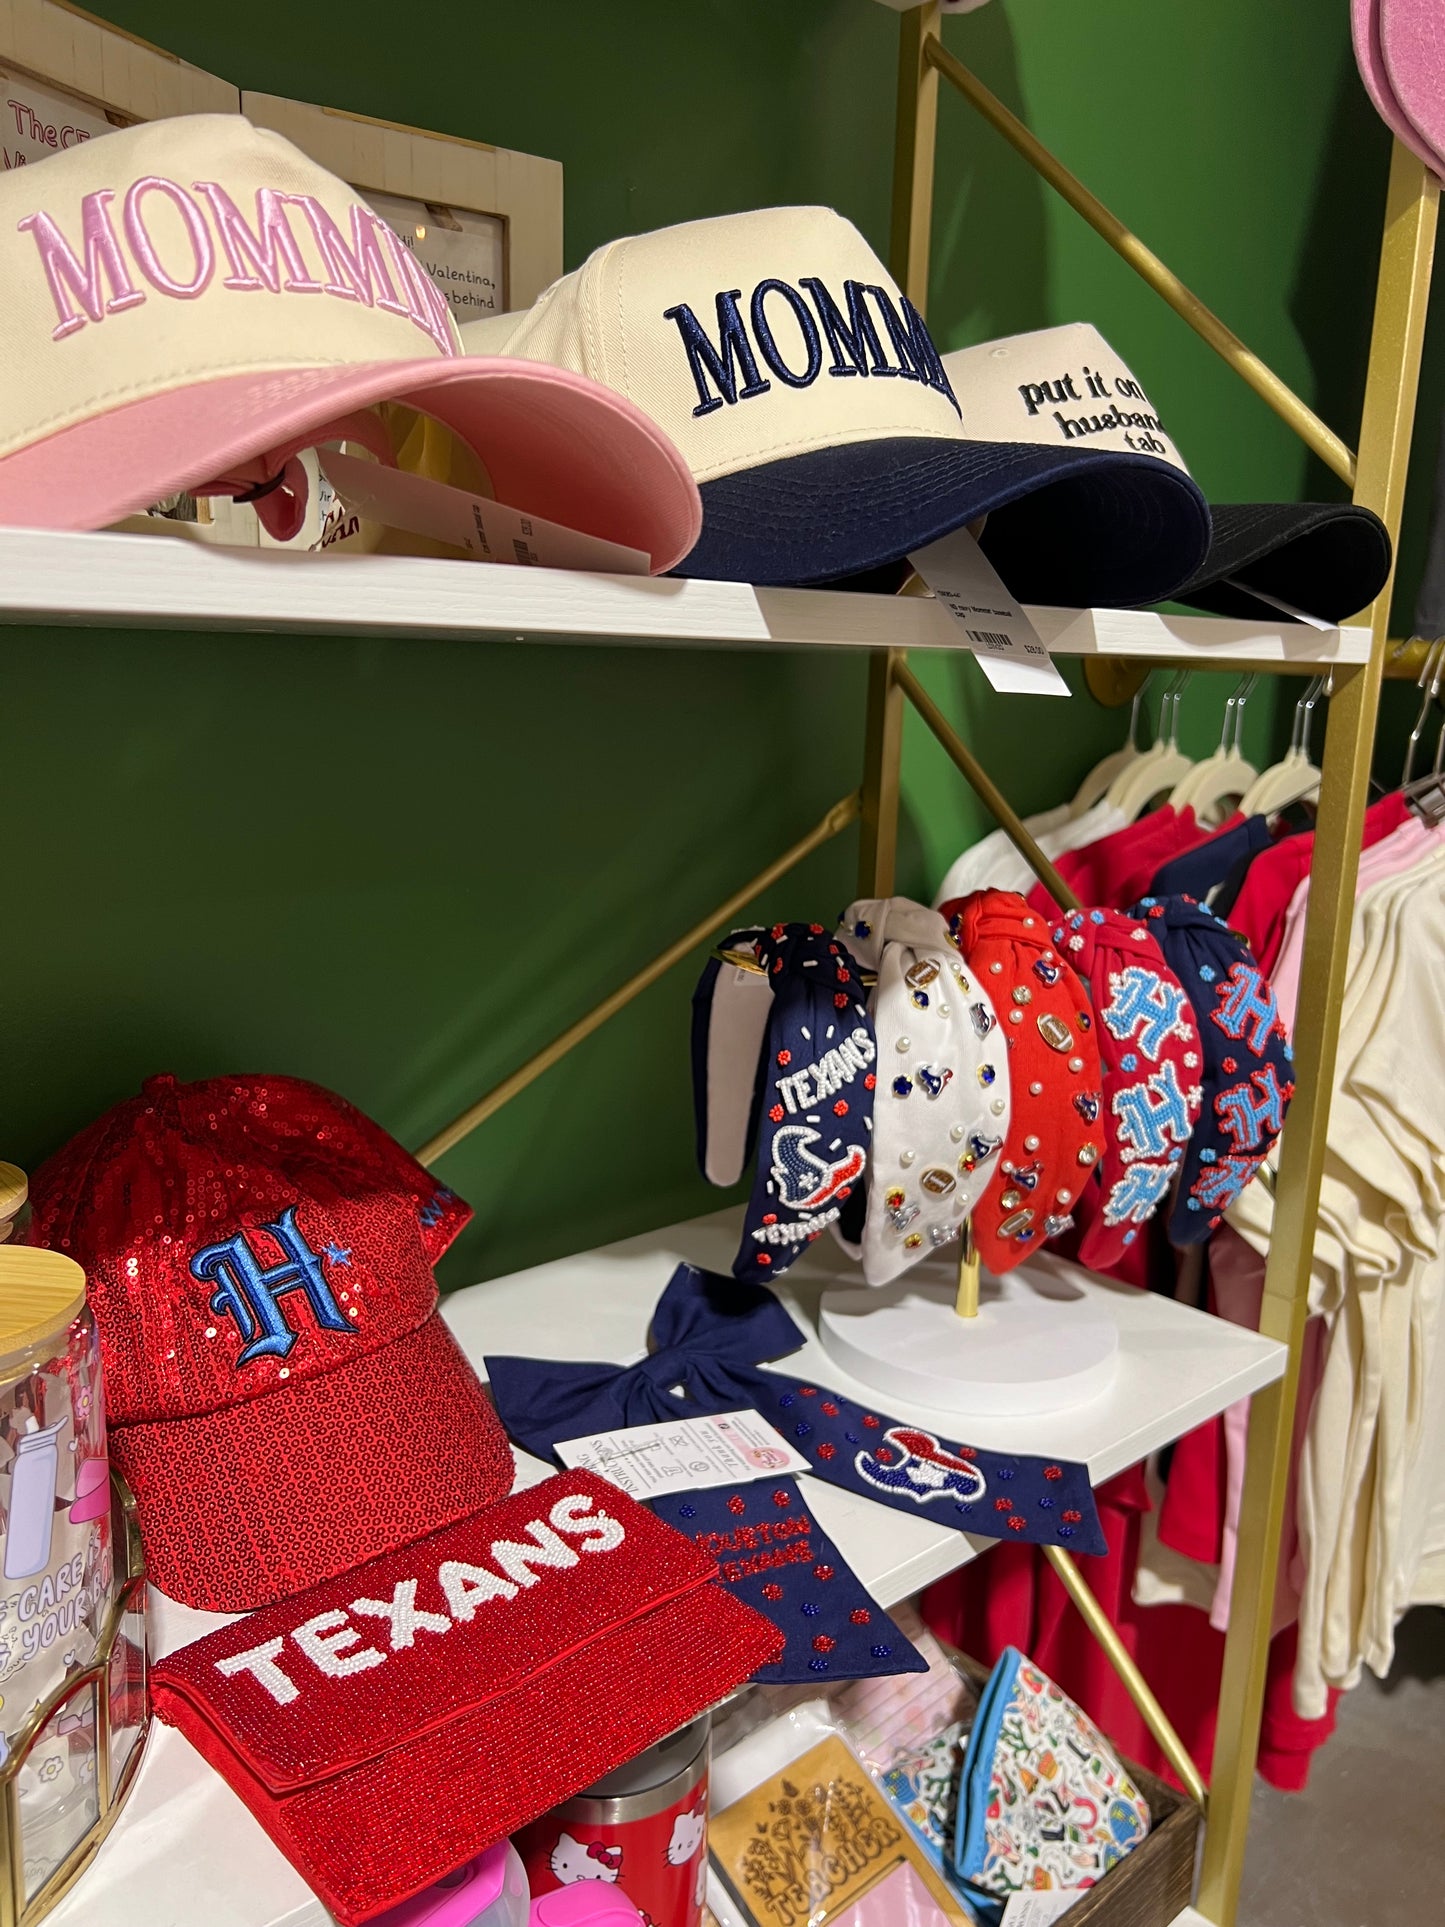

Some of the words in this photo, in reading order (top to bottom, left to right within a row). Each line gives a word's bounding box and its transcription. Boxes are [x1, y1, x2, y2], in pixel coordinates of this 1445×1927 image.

[7, 99, 58, 148] The
[426, 262, 496, 290] Valentina,
[452, 290, 496, 309] behind
[1018, 373, 1082, 415] put
[1083, 366, 1112, 398] it
[1115, 377, 1148, 402] on
[1053, 404, 1166, 440] husban
[1124, 431, 1167, 455] tab
[776, 1027, 876, 1114] TEXANS
[189, 1204, 360, 1369] H
[18, 1552, 83, 1622] CARE
[214, 1494, 626, 1706] TEXANS
[22, 1587, 88, 1661] YOUR
